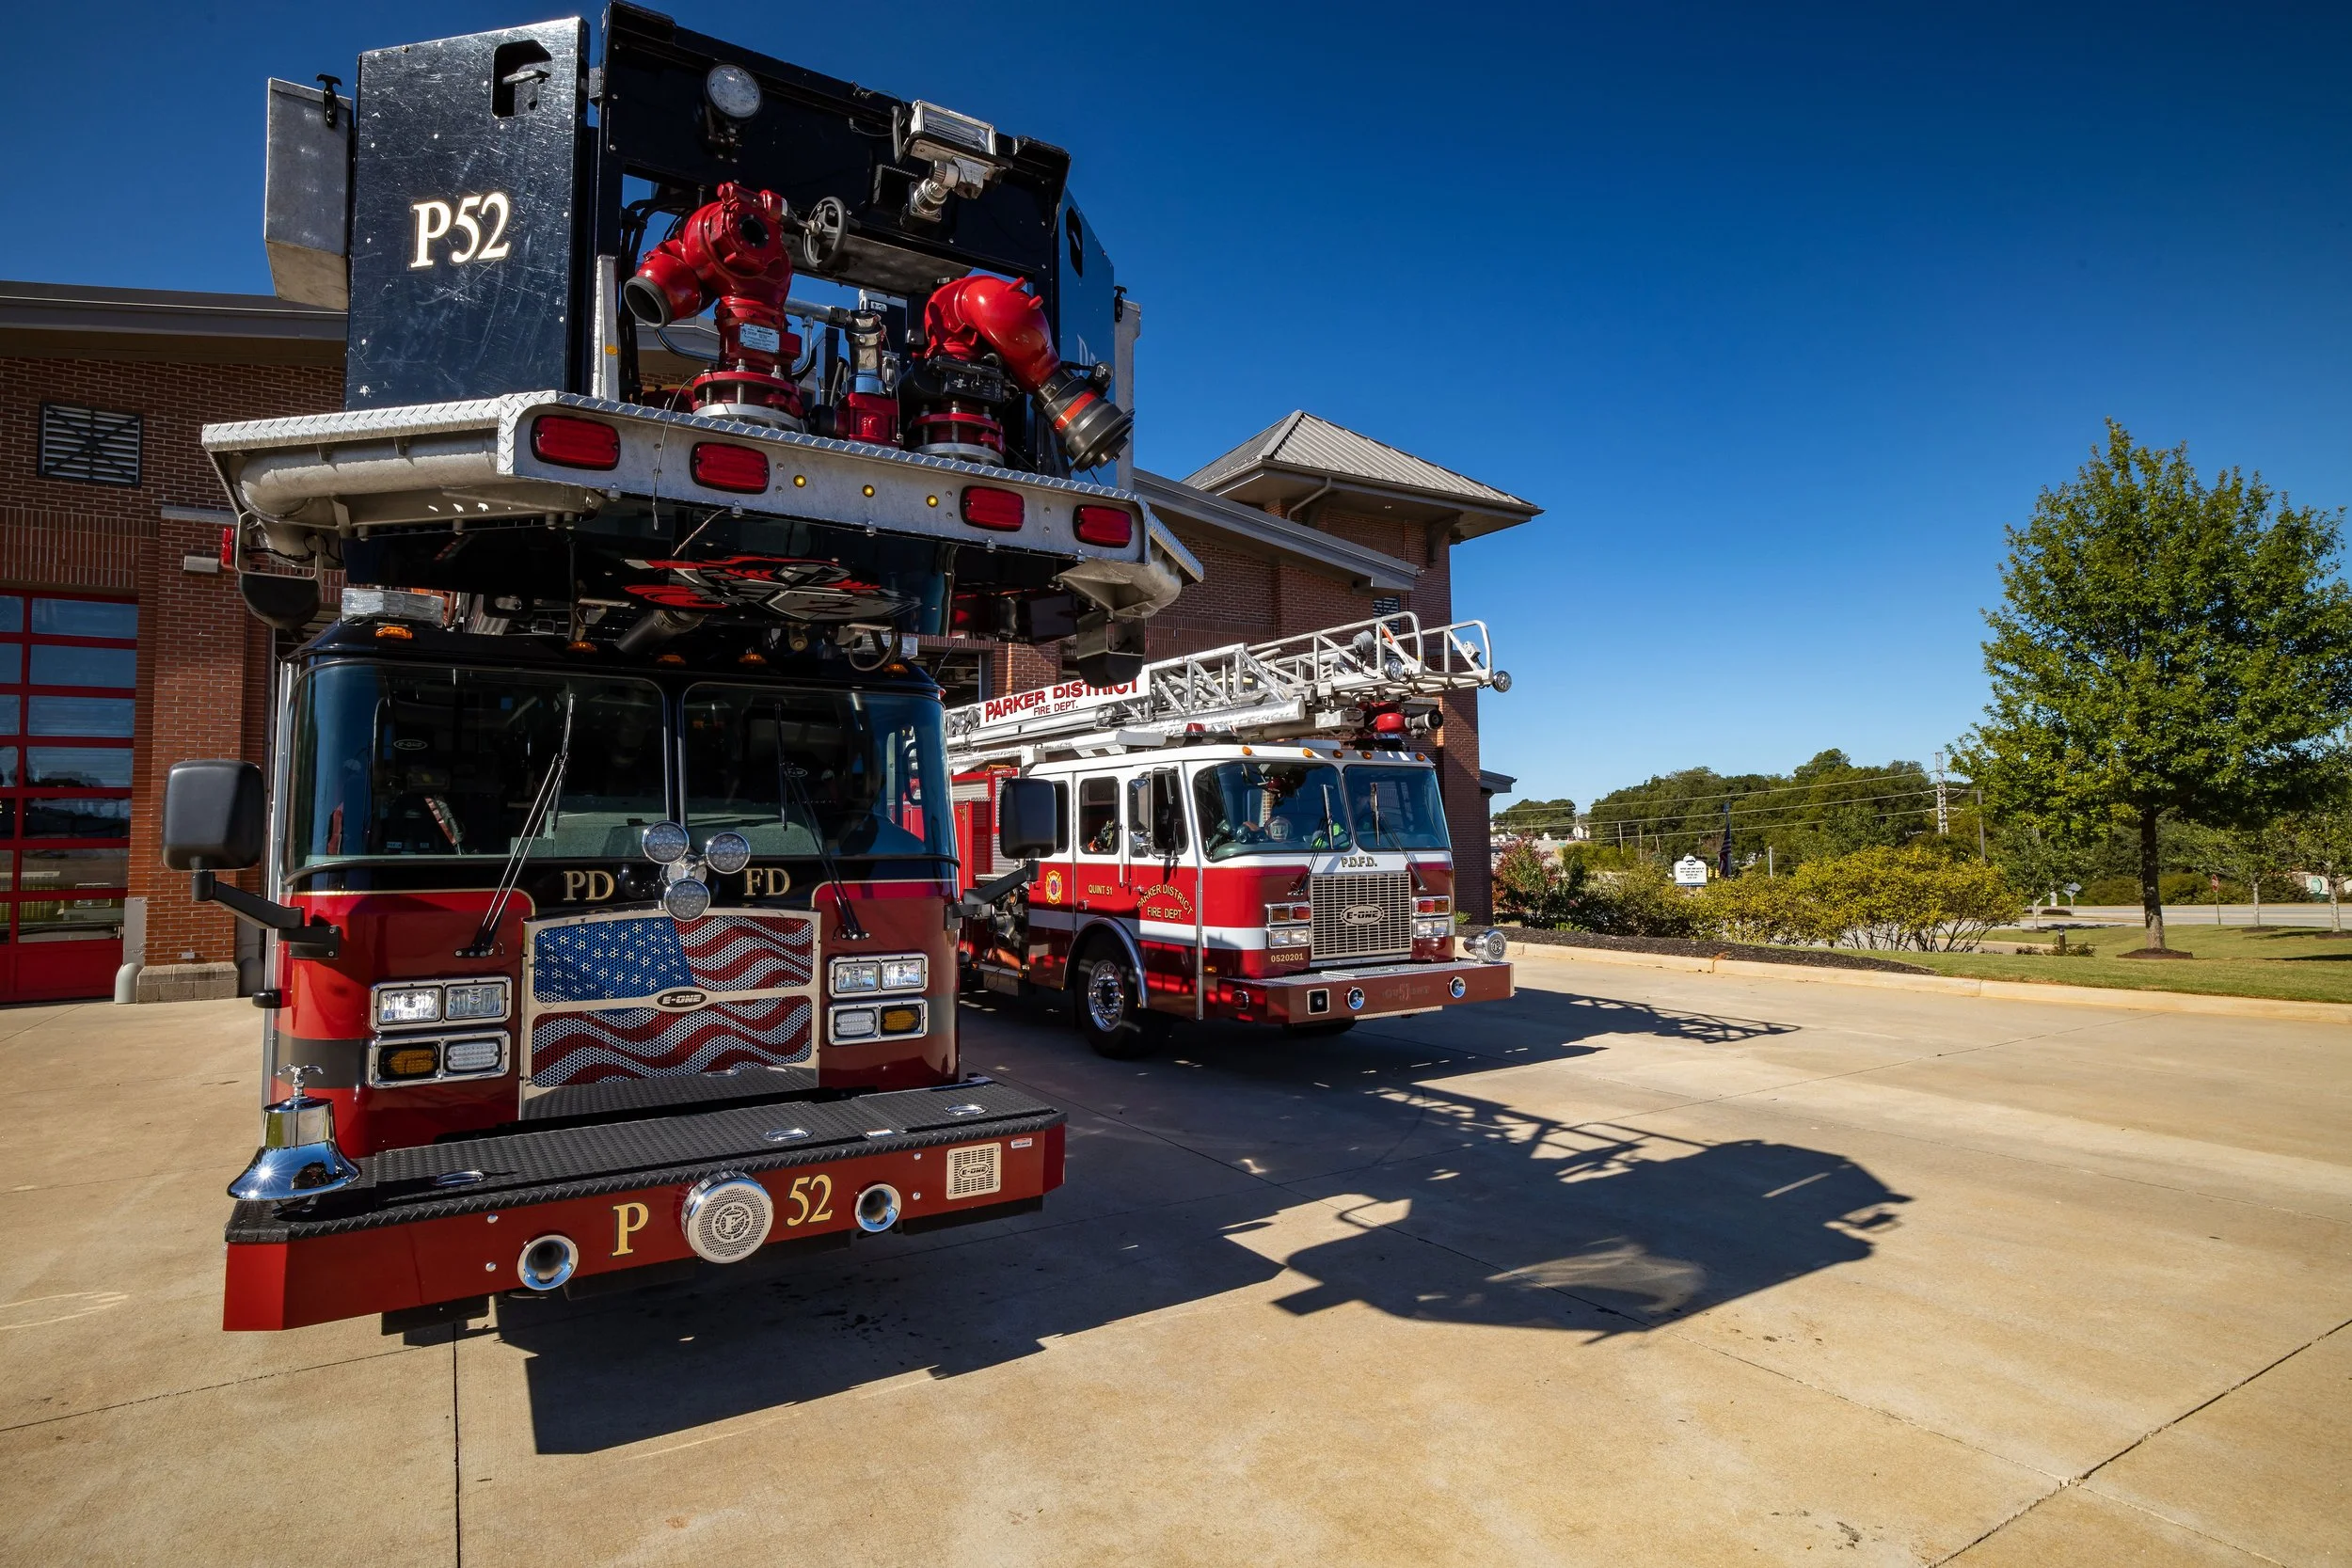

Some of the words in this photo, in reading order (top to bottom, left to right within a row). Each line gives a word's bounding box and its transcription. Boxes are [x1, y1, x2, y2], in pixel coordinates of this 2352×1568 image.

[409, 192, 510, 268] P52
[985, 690, 1046, 722] PARKER
[1033, 705, 1051, 716] FIRE
[1054, 700, 1078, 712] DEPT.
[564, 871, 614, 901] PD
[743, 868, 790, 895] FD
[1088, 884, 1106, 895] QUINT
[1106, 885, 1113, 895] 51
[1136, 884, 1162, 911] PARKER
[1163, 884, 1193, 914] DISTRICT
[1147, 906, 1162, 918] FIRE
[1164, 908, 1184, 920] DEPT.
[1346, 910, 1379, 920] E-ONE
[1270, 953, 1304, 962] 0520201
[661, 994, 702, 1005] E-ONE
[961, 1166, 988, 1176] E-ONE
[611, 1202, 649, 1257] P
[787, 1174, 834, 1227] 52
